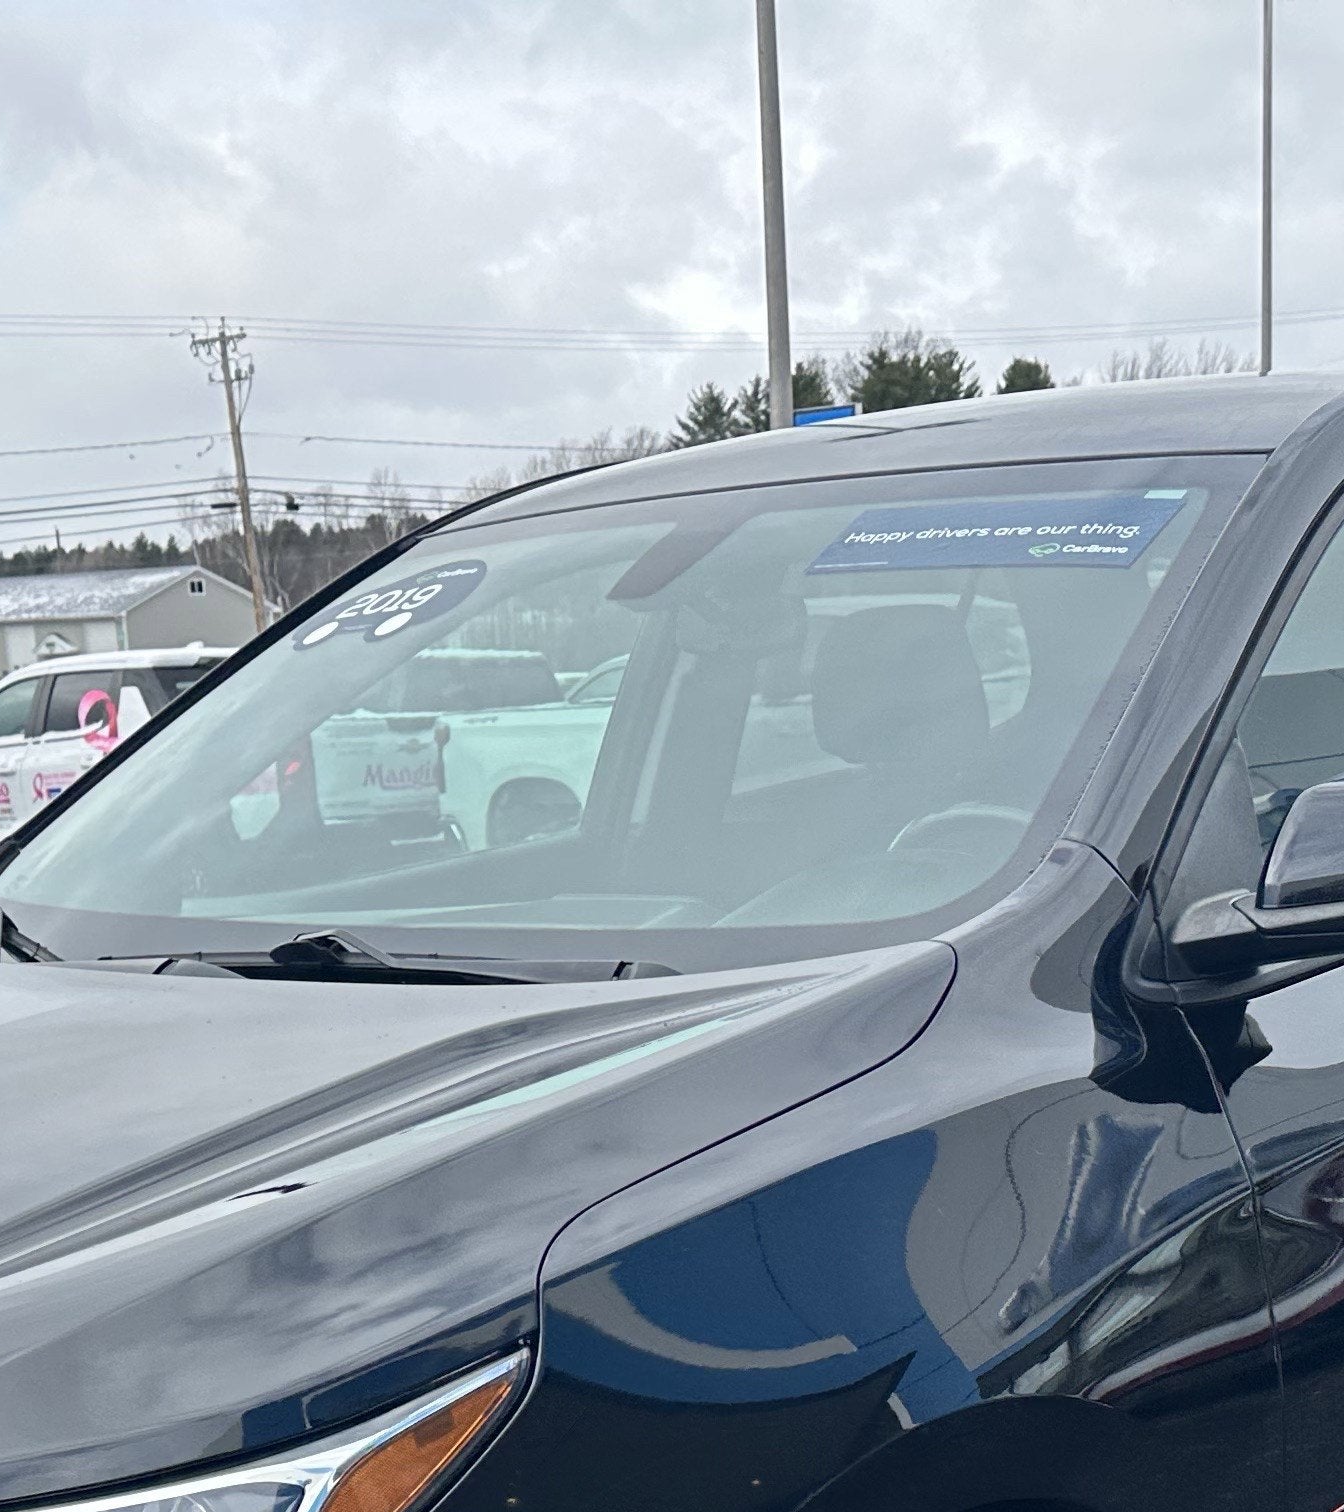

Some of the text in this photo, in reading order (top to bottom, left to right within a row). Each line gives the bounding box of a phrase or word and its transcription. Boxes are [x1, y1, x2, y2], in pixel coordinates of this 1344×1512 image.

[844, 523, 1140, 544] Happy drivers are our thing.
[1062, 544, 1129, 554] CarBravo
[335, 583, 442, 620] 2019
